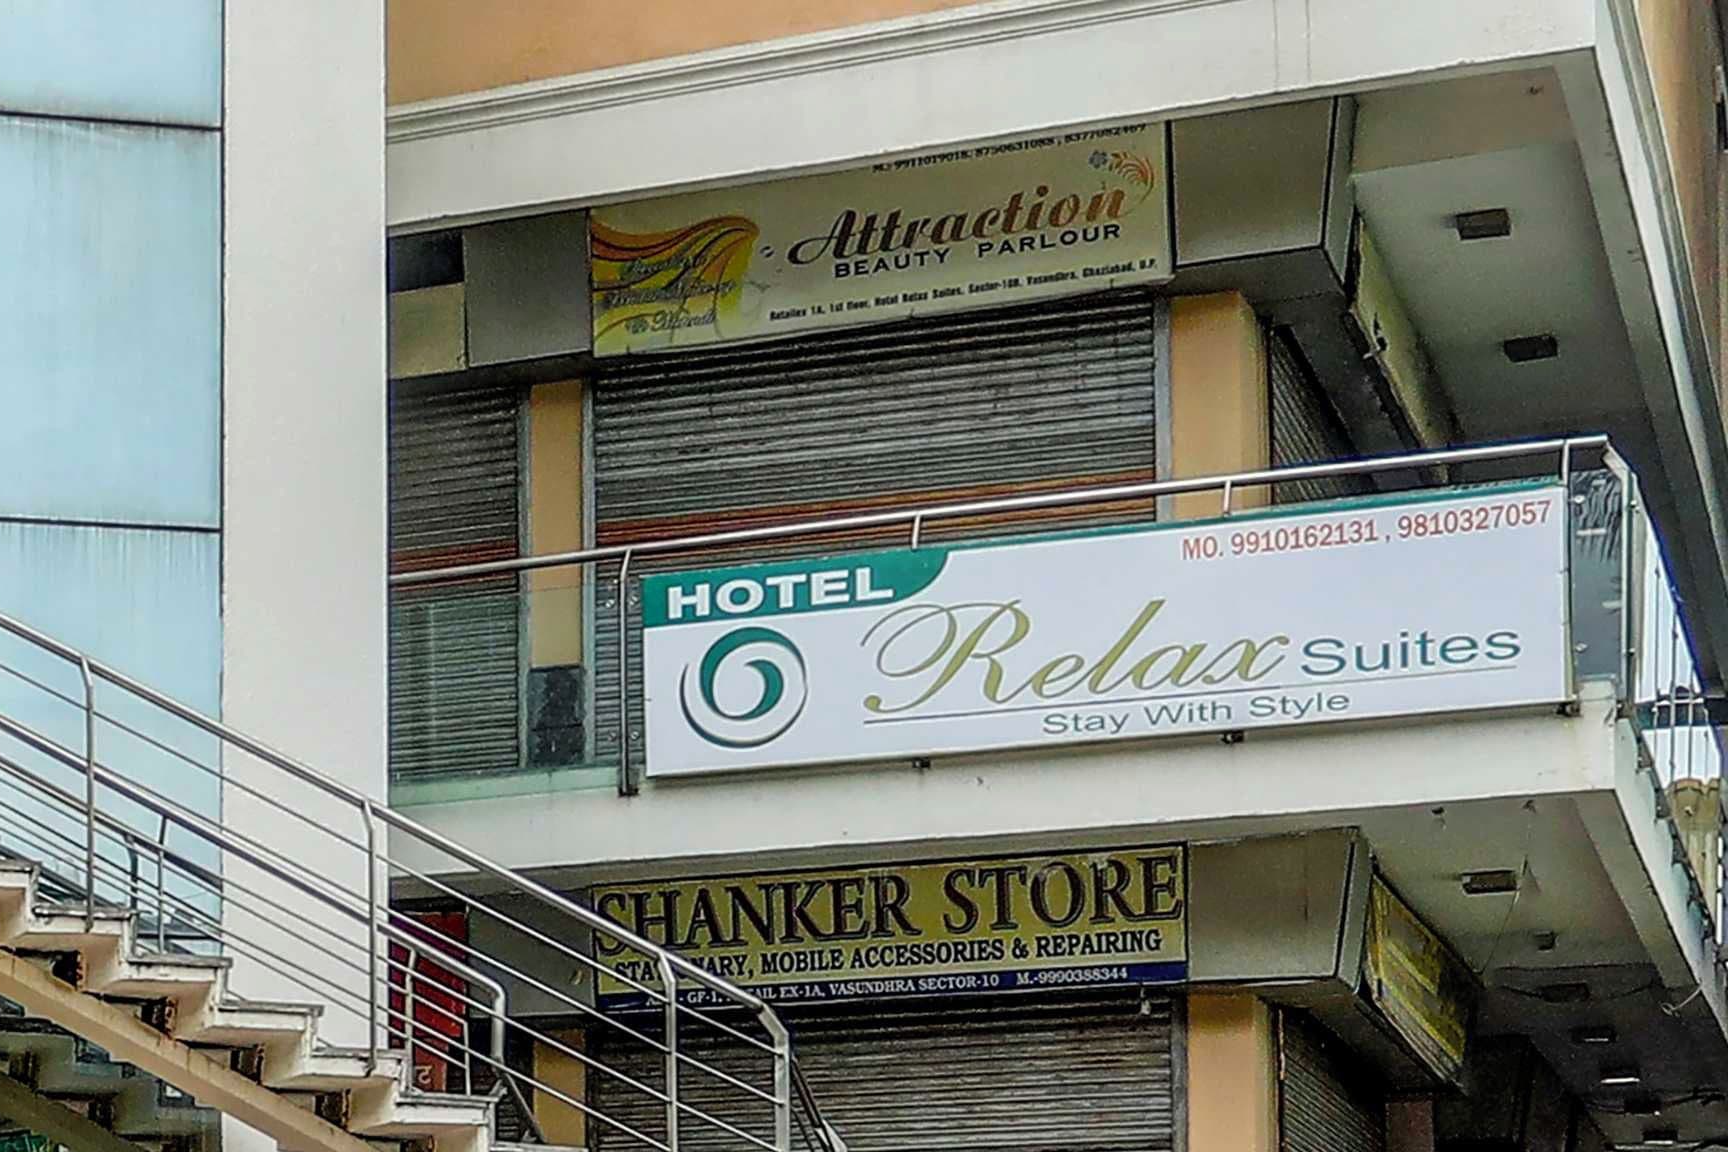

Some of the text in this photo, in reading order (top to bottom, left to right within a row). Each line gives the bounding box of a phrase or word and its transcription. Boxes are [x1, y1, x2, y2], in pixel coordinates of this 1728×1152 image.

[787, 184, 1126, 265] Attraction
[834, 223, 1121, 278] BEAUTY PARLOUR
[1181, 535, 1225, 562] MO.
[1397, 499, 1553, 540] 9810327057
[667, 567, 894, 619] HOTEL
[860, 598, 1522, 714] Relax Suites
[1043, 691, 1351, 737] Stay With Style
[593, 853, 1185, 956] SHANKER STORE
[761, 948, 846, 975] MOBILE
[846, 939, 1005, 969] ACCESSORIES
[1011, 936, 1029, 960] &
[1035, 928, 1162, 958] REPAIRING
[829, 978, 917, 997] VASUNDHRA
[918, 974, 1000, 992] SECTOR-10
